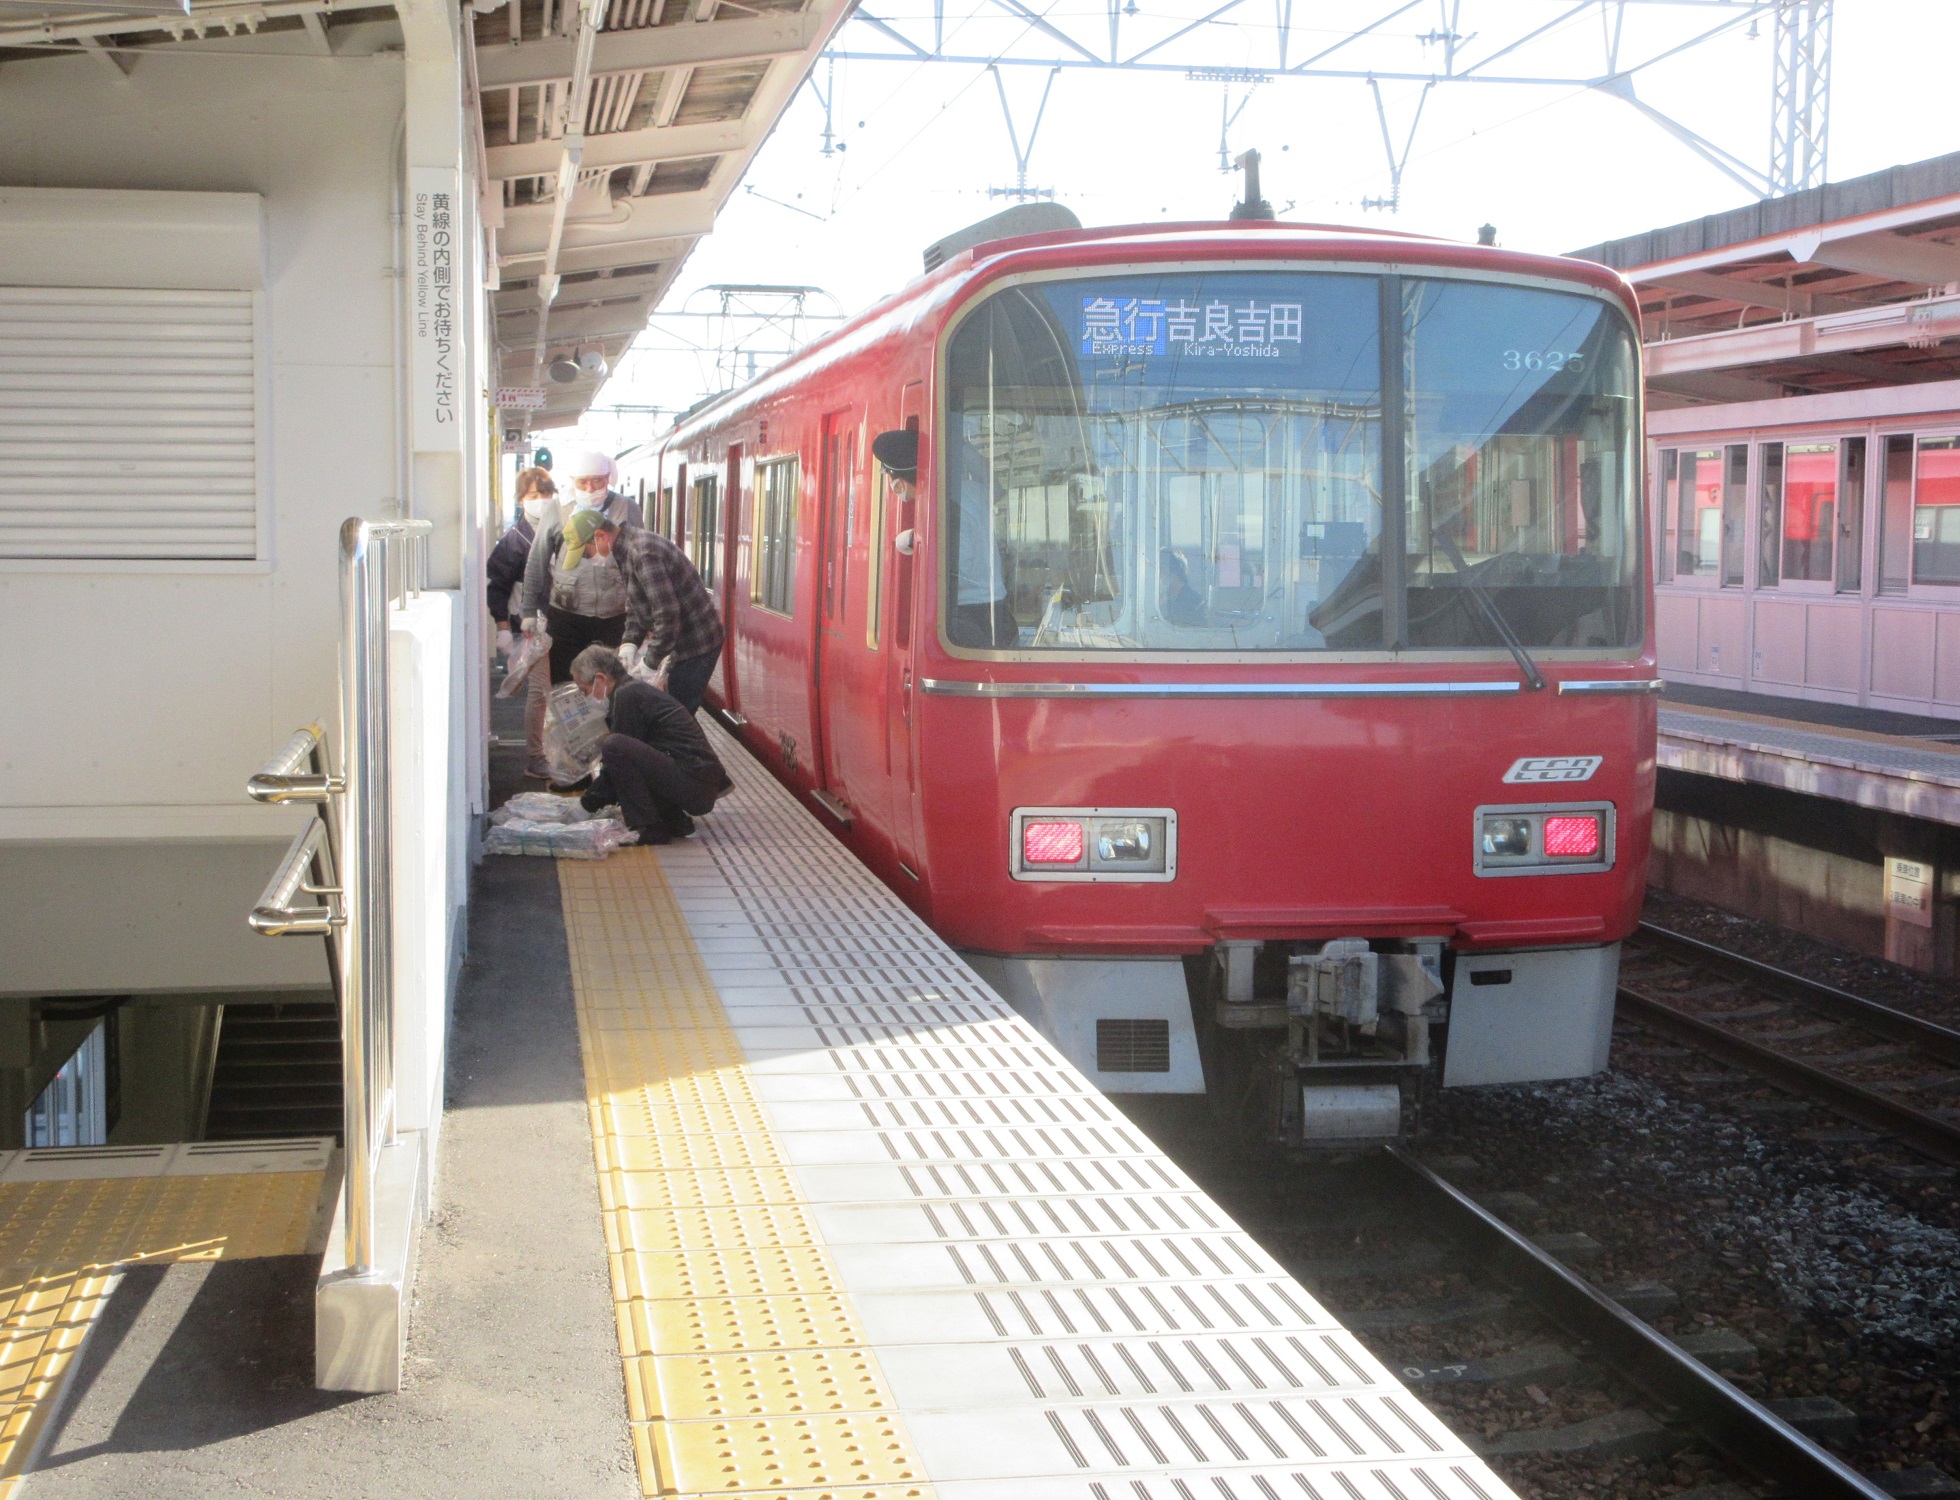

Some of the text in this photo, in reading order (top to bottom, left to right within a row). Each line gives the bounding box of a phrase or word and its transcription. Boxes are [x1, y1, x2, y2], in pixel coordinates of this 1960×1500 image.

[414, 193, 430, 338] Stay Behind Yellow Line
[432, 192, 453, 424] 黄線の内側でお待ちください
[1082, 297, 1302, 344] 急行 吉良吉田
[1092, 341, 1280, 358] Express Kira-Yoshida
[1503, 349, 1586, 373] 3625
